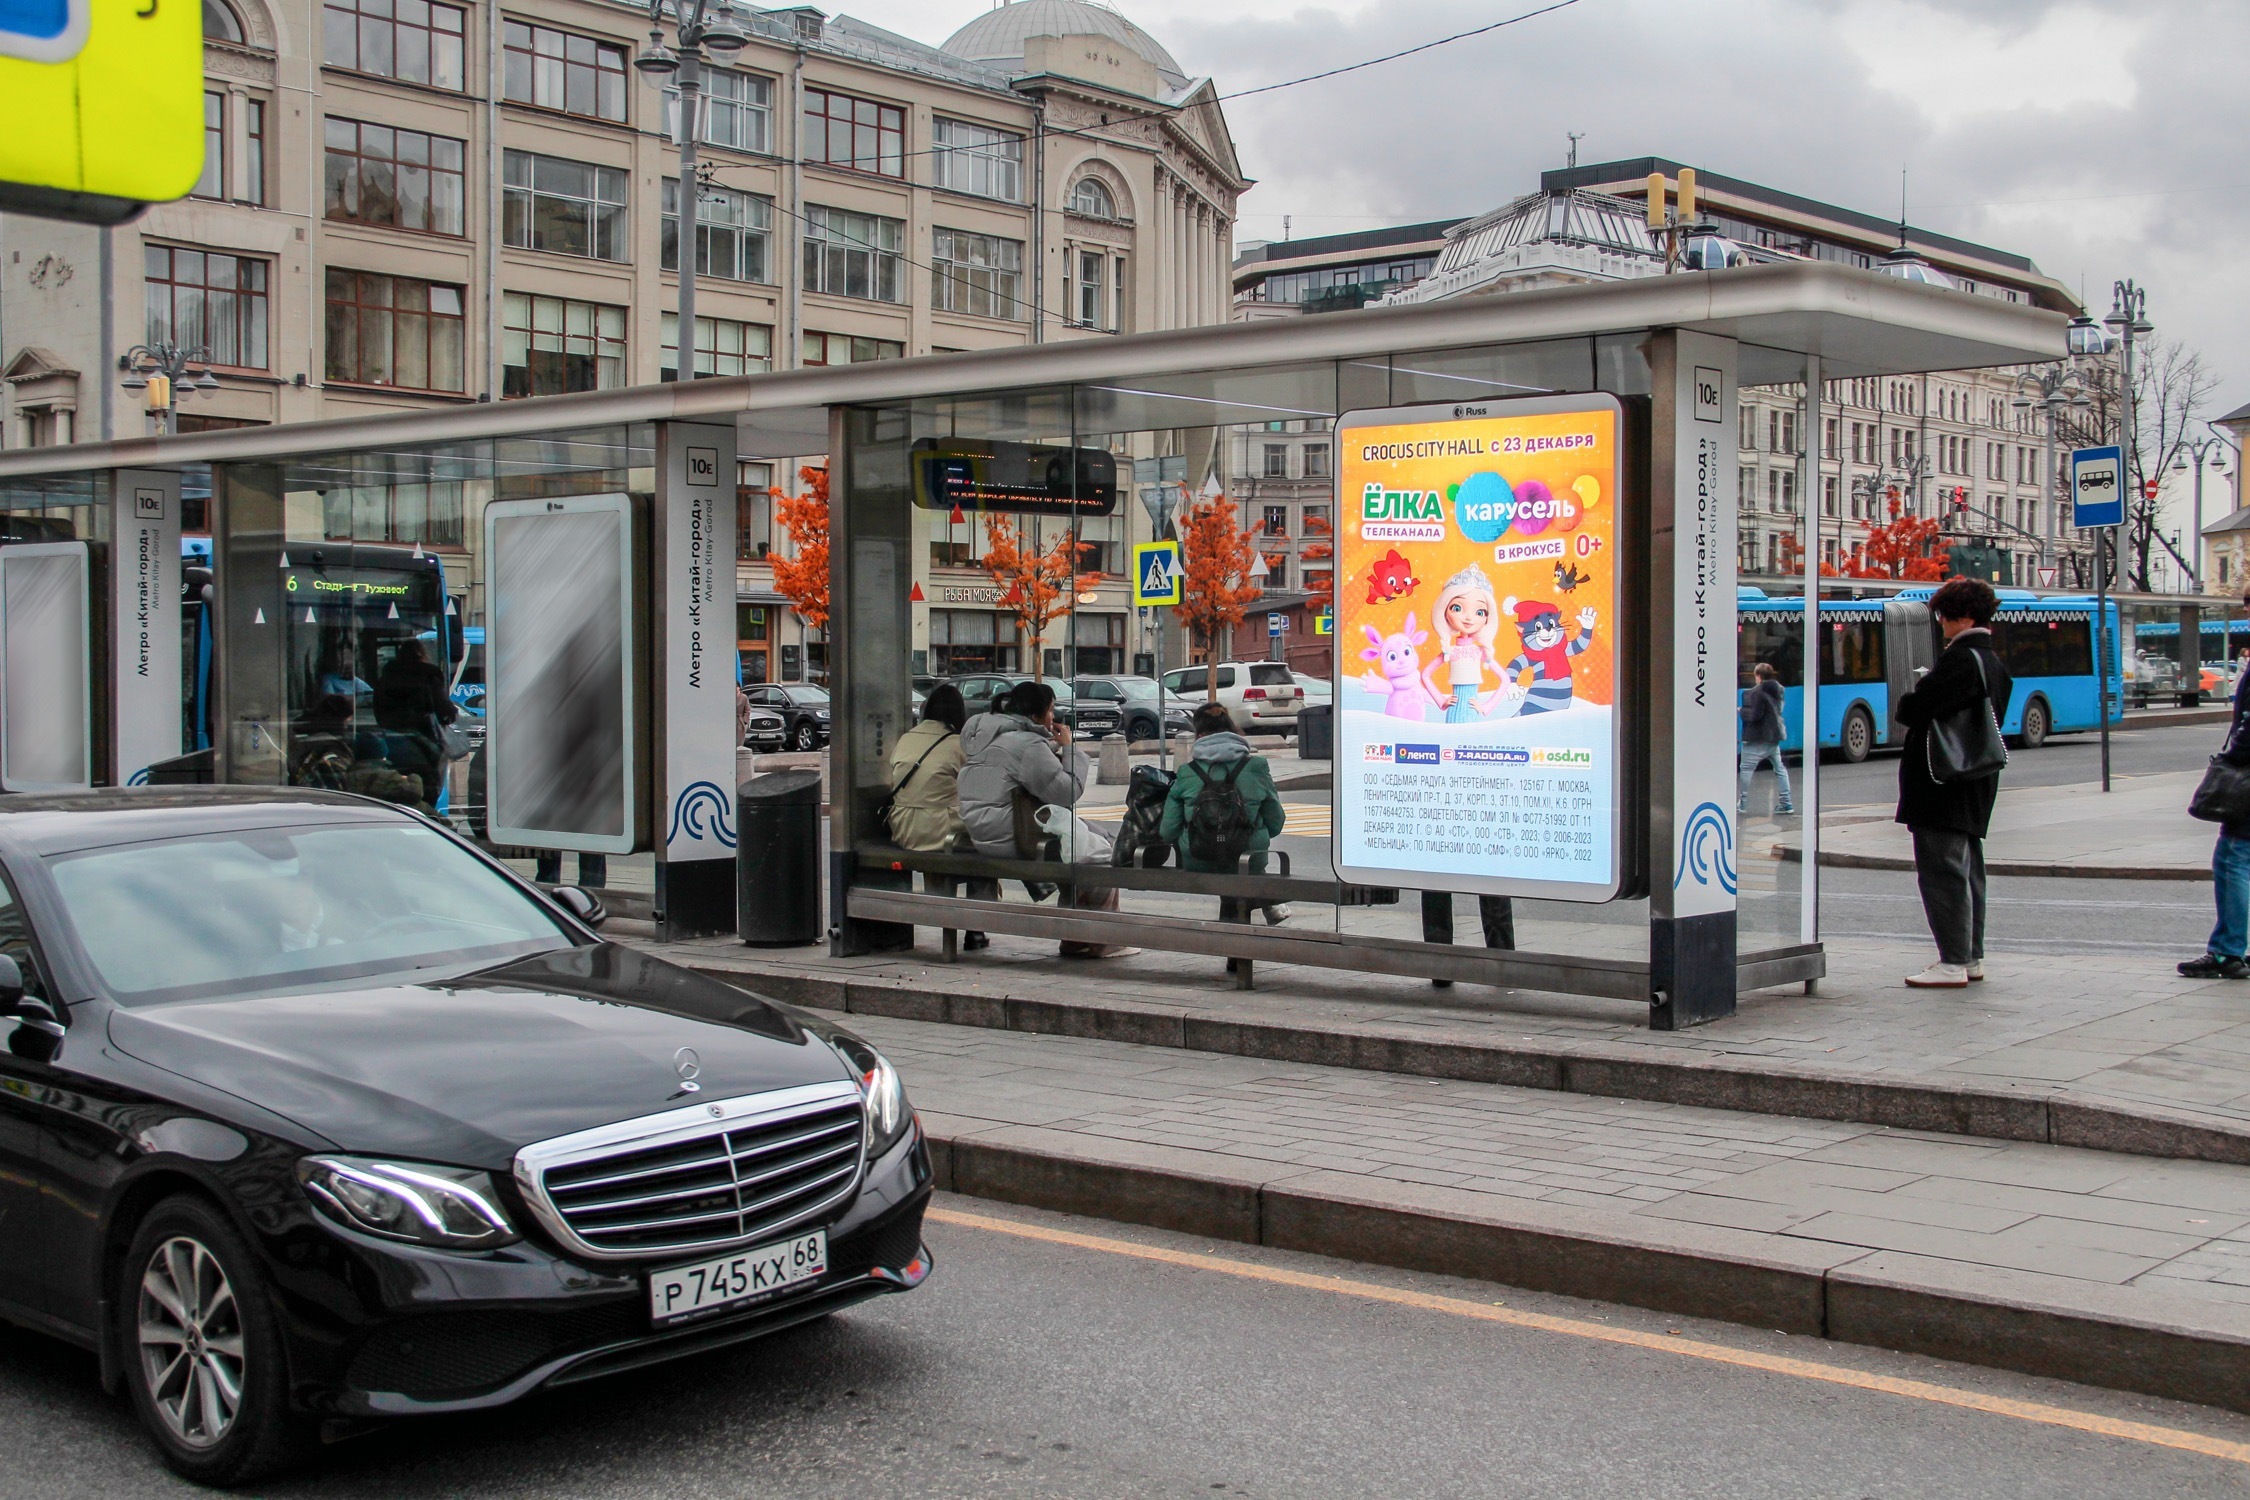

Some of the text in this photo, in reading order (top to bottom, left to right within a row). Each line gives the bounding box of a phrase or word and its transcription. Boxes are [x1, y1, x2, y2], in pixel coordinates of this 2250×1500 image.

[1466, 407, 1487, 416] Russ
[1363, 438, 1484, 460] CROCUS CITY HALL
[1504, 437, 1521, 451] 23
[1525, 435, 1593, 453] ДЕКАБРЯ
[1364, 485, 1442, 519] ЁЛКА
[1709, 441, 1718, 586] Metro Kitay-Gorod
[1366, 527, 1440, 537] ТЕЛЕКАНАЛА
[705, 499, 715, 603] Metro Kitay-Gorod
[1498, 542, 1561, 560] В КРОКУСЕ
[1577, 535, 1602, 556] 0+
[1695, 438, 1707, 707] Метро «Китай-город»
[286, 576, 298, 591] 6
[688, 499, 703, 689] Метро «Китай-город»
[138, 529, 150, 677] Метро «Китай-город»
[152, 589, 160, 609] Metro
[973, 588, 991, 602] МОЯ
[1407, 752, 1436, 760] лента
[1457, 752, 1526, 761] 7-RADUGA.RU
[1547, 749, 1589, 762] osd.ru
[1364, 773, 1378, 785] ООО
[1382, 774, 1417, 787] «СЕДЬМАЯ
[1420, 775, 1446, 789] РАДУГА
[1520, 779, 1544, 791] 125167
[1558, 780, 1592, 794] МОСКВА,
[1364, 788, 1421, 803] ЛЕНИНГРАДСКИЙ
[1424, 791, 1442, 805] ПР-Т,
[1454, 793, 1464, 806] 37,
[1466, 793, 1488, 806] КОРП.
[1491, 794, 1497, 807] 3,
[1500, 794, 1520, 808] ЭТ.10,
[1572, 797, 1592, 810] ОГРН
[1364, 805, 1591, 827] 1167746442753. СВИДЕТЕЛЬСТВО СМИ ЭЛ № ФС77-51992 ОТ 11
[1364, 821, 1394, 833] ДЕКАБРЯ
[1397, 823, 1413, 835] 2012
[1416, 823, 1422, 835] Г.
[1425, 824, 1432, 835] ©
[1435, 825, 1445, 836] АО
[1448, 825, 1472, 839] «СТС»,
[1475, 827, 1490, 839] ООО
[1520, 829, 1540, 843] 2023;
[1543, 830, 1551, 842] ©
[1553, 831, 1592, 844] 2006-2023
[1414, 840, 1423, 852] ПО
[1425, 841, 1464, 854] ЛИЦЕНЗИИ
[1466, 843, 1481, 855] ООО
[1523, 846, 1539, 858] ООО
[1542, 847, 1572, 861] «ЯРКО»,
[1574, 849, 1592, 861] 2022
[794, 1237, 818, 1267] 68
[793, 1266, 811, 1278] RUS
